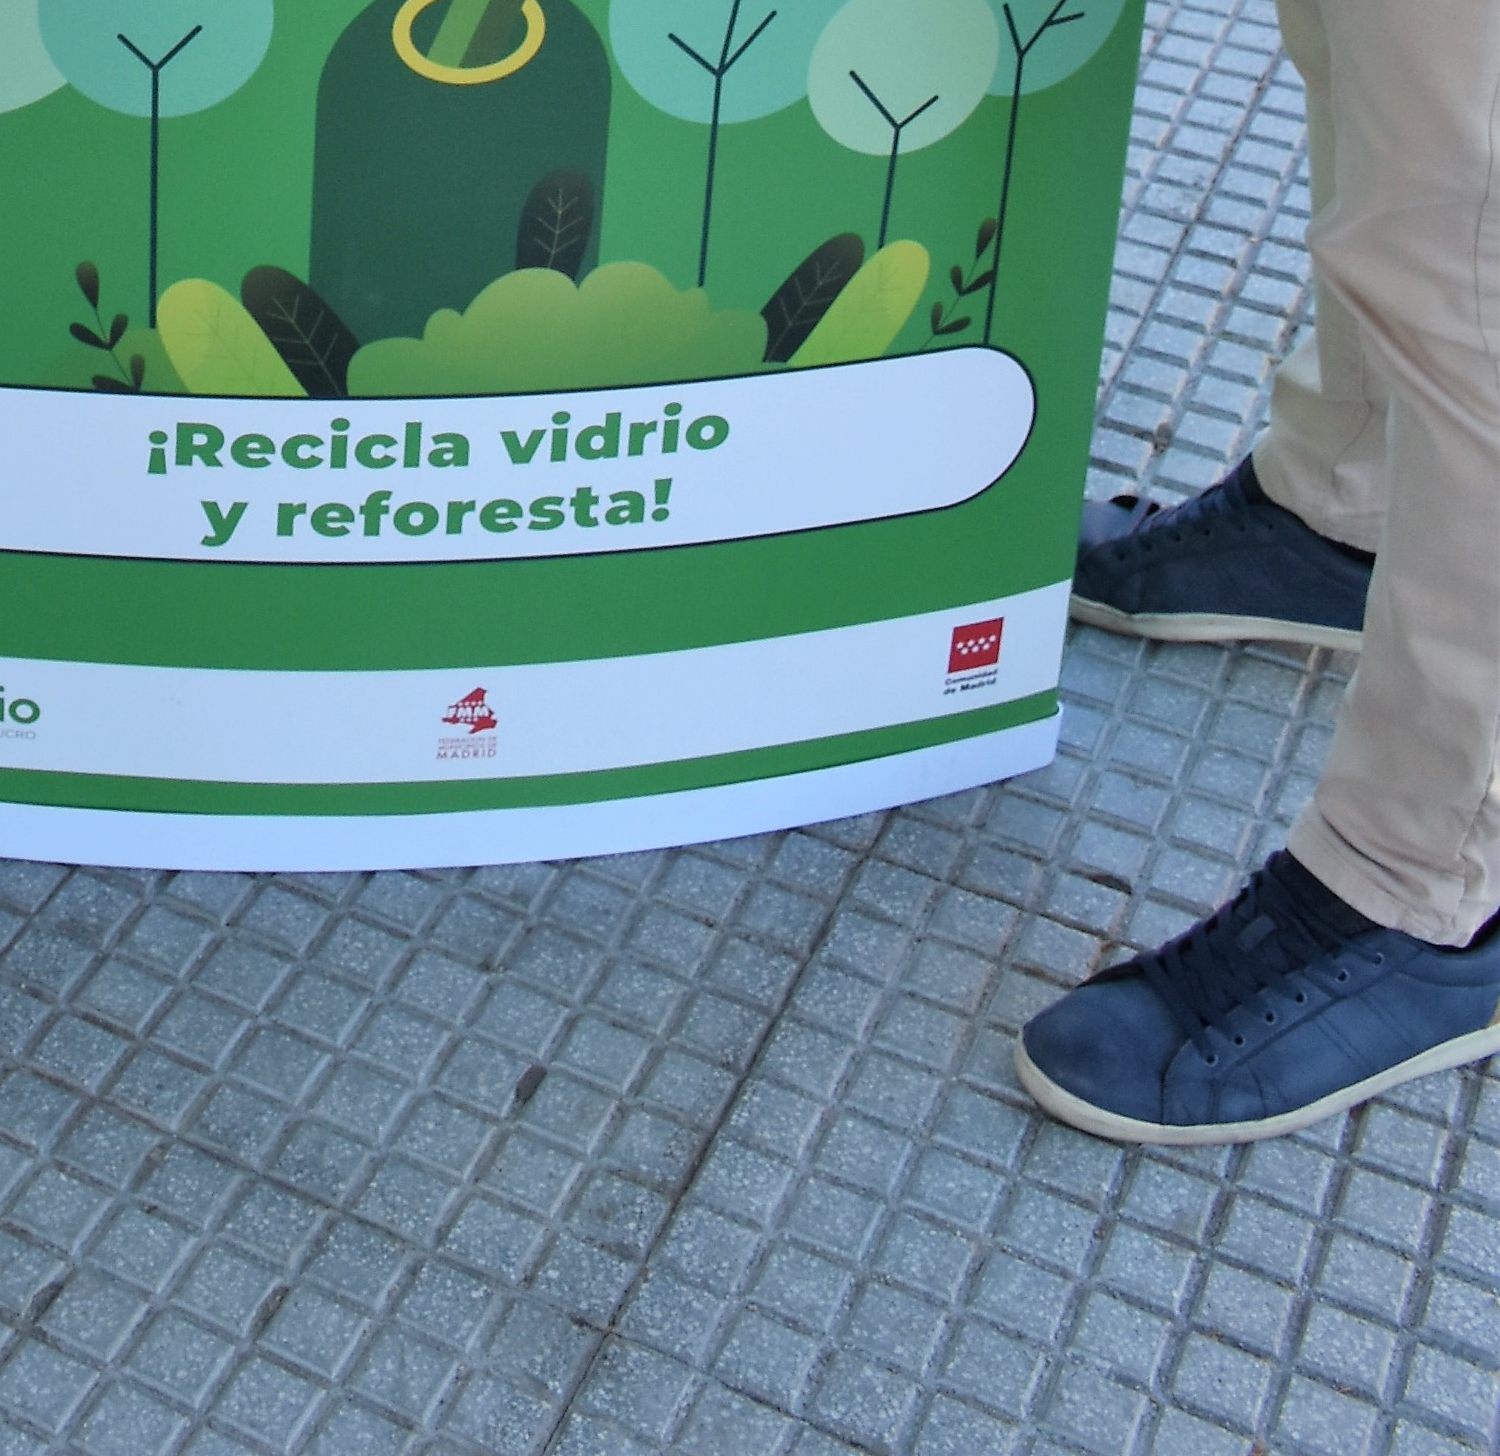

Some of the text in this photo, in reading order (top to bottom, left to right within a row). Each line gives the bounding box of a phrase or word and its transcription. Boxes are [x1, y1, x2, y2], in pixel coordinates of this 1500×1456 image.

[147, 402, 731, 476] ¡Recicla vidrio
[200, 477, 674, 548] y reforesta!
[436, 749, 497, 760] MADRID
